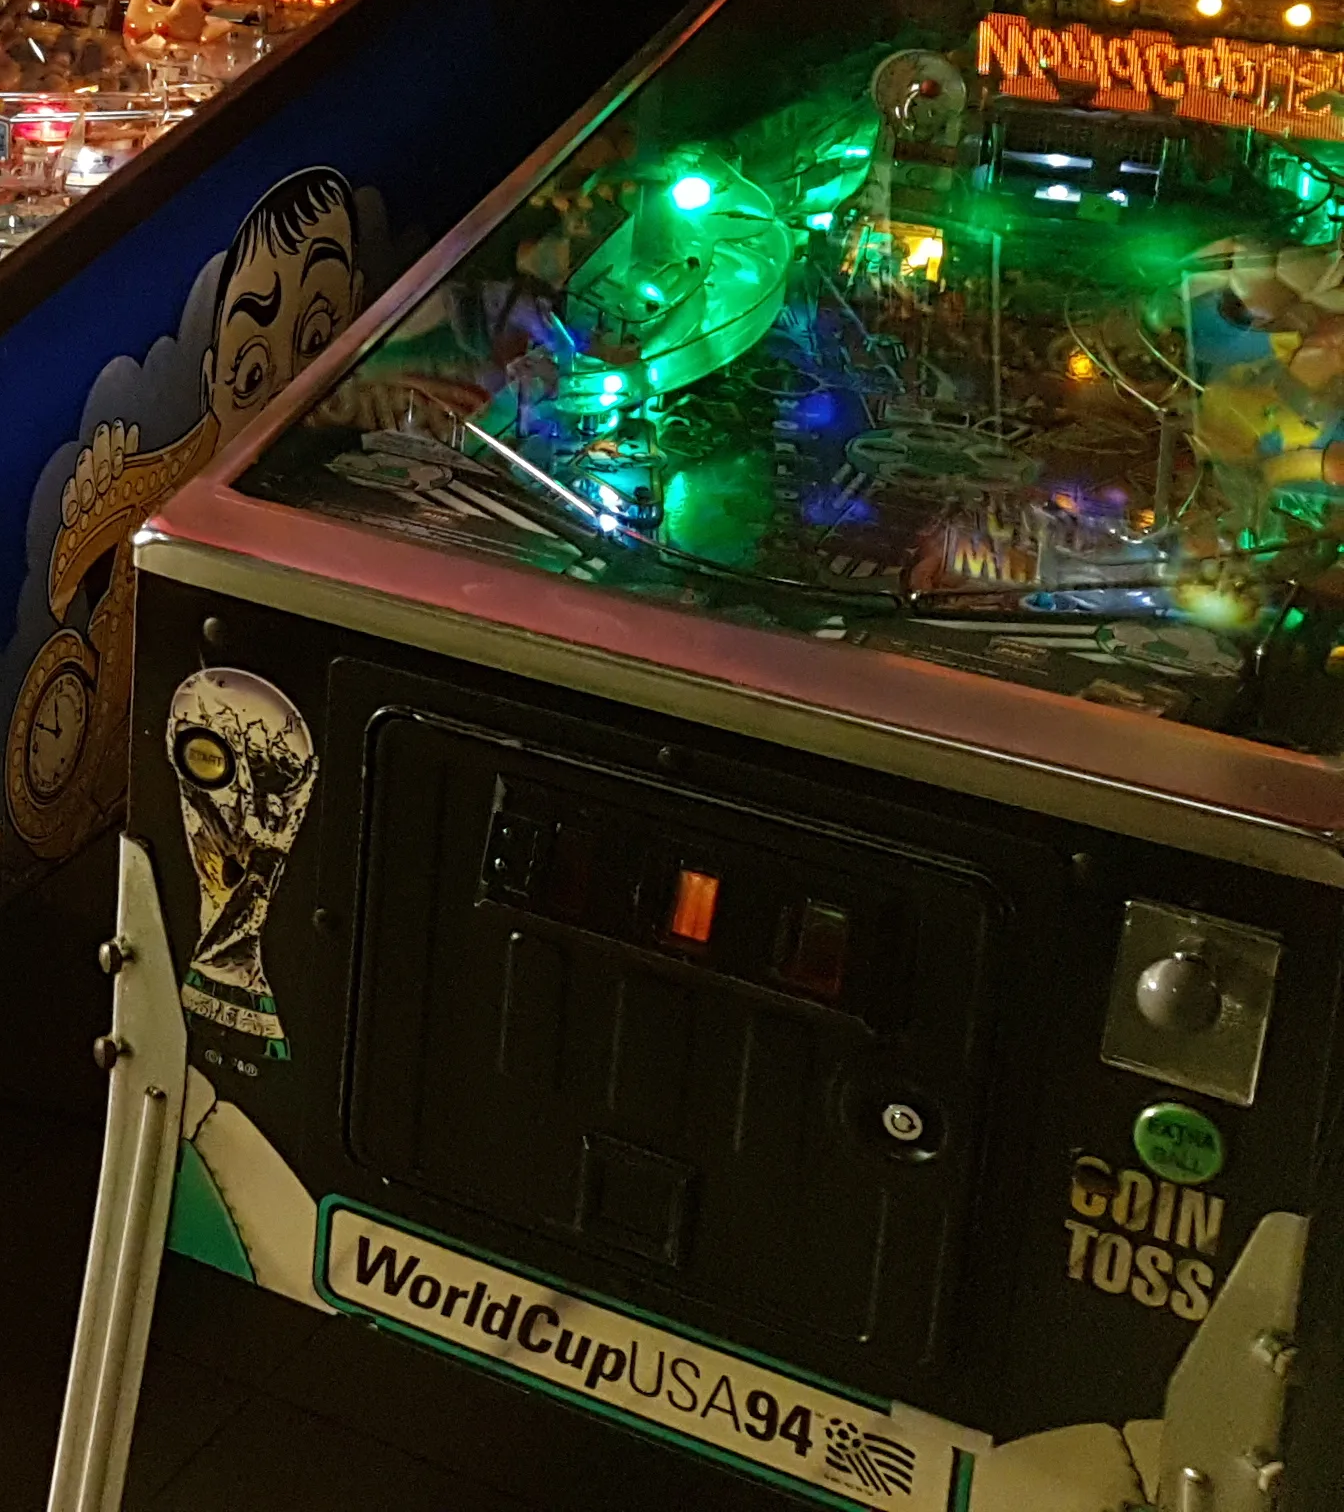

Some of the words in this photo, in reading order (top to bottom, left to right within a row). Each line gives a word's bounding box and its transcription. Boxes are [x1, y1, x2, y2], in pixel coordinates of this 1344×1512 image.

[1070, 1155, 1225, 1256] COIN
[1063, 1218, 1215, 1322] TOSS
[355, 1234, 814, 1459] WorldCupUSA94
